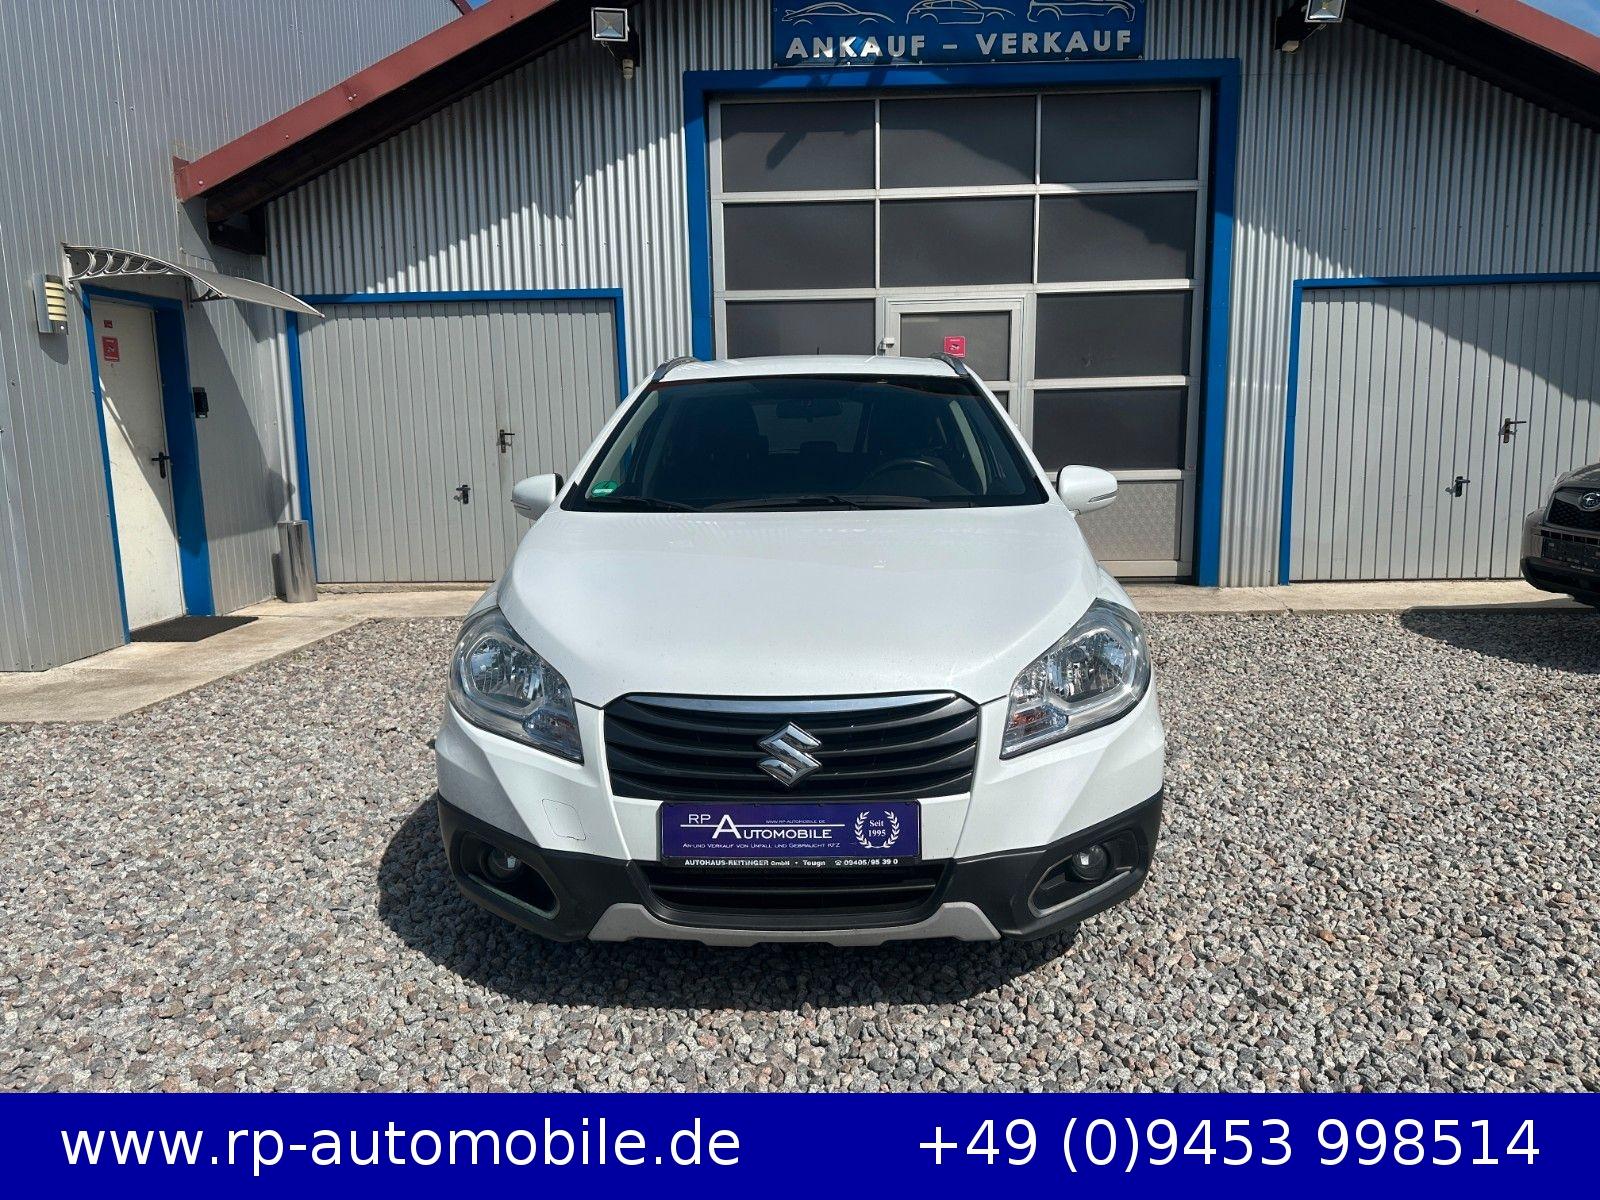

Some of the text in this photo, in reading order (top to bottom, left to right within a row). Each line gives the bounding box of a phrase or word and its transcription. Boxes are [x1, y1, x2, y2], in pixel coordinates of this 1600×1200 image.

[786, 35, 925, 58] ANKAUF
[976, 30, 1131, 55] VERKAUF
[688, 814, 711, 824] RP
[868, 829, 886, 837] 1995
